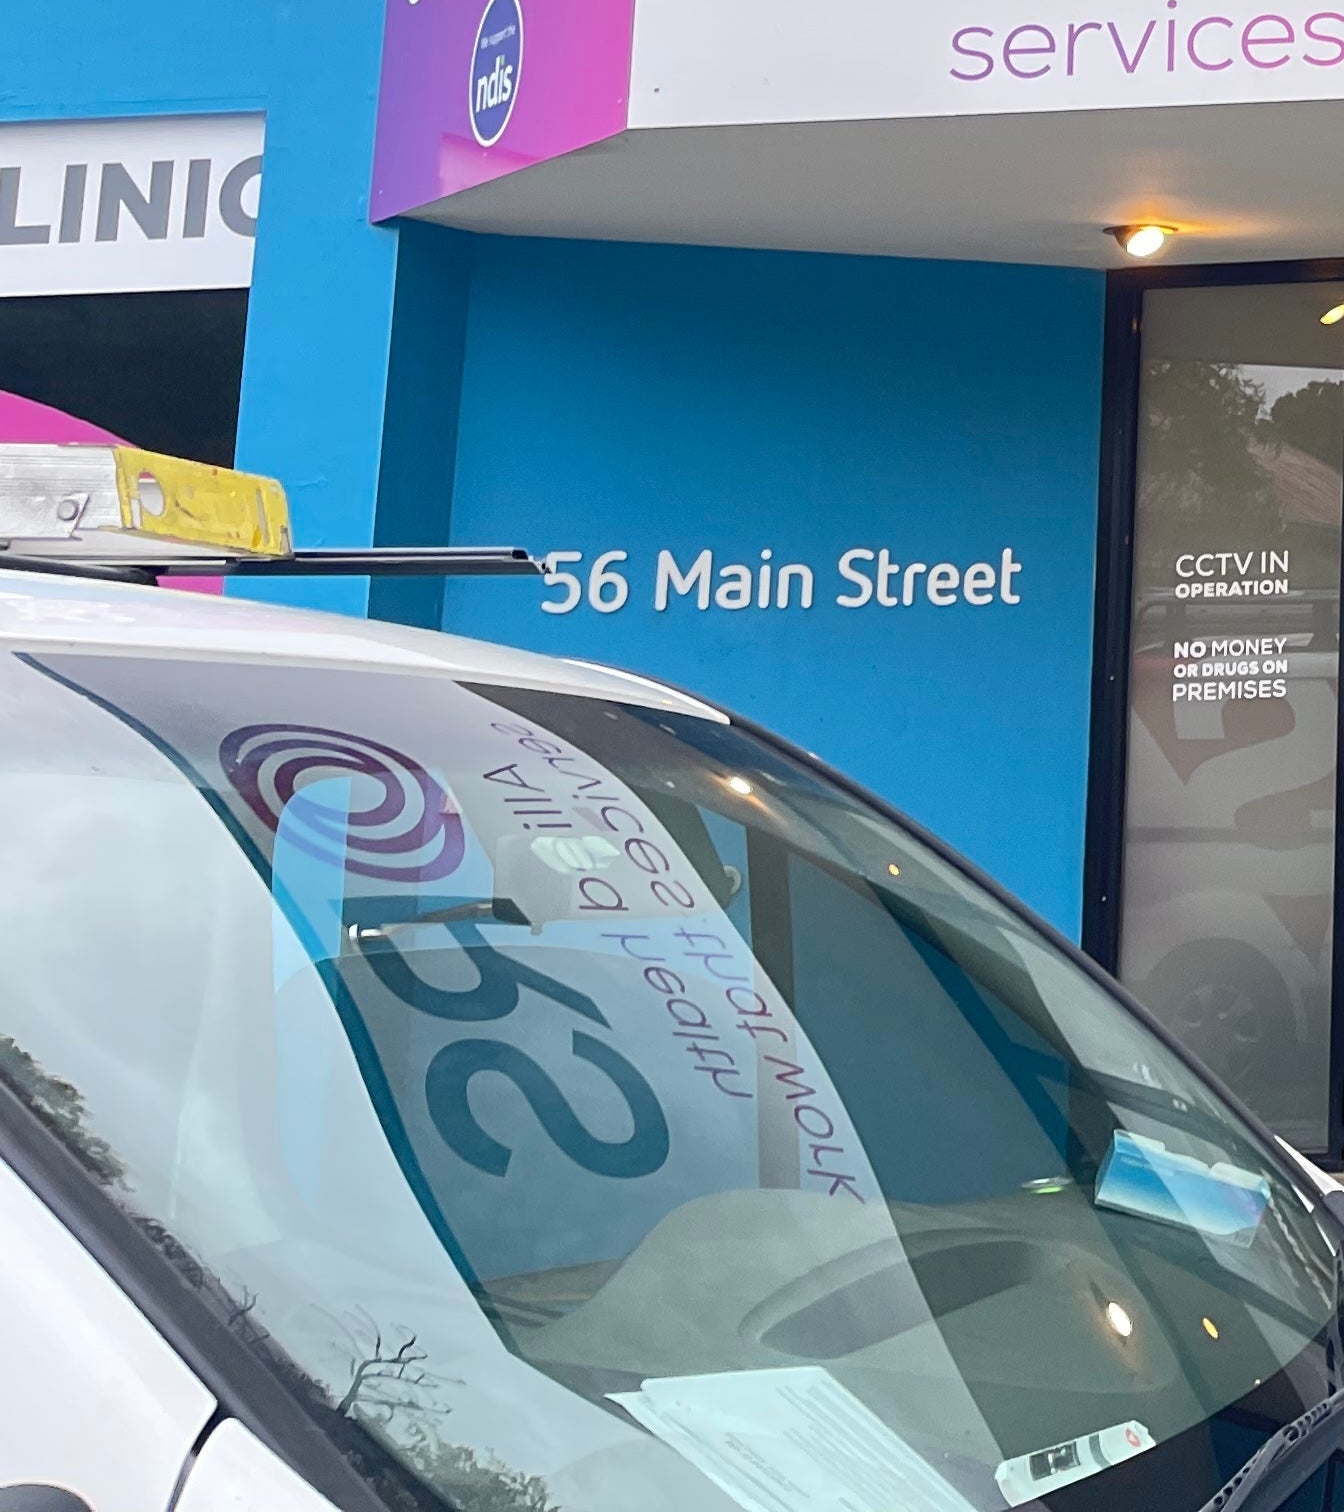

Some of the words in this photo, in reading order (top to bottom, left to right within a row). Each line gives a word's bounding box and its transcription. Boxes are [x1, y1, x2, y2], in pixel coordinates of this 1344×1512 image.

[475, 55, 513, 114] ndis
[1175, 551, 1254, 578] CCTV
[1260, 549, 1290, 574] IN
[539, 550, 630, 616] 56
[653, 548, 814, 612] Main
[836, 546, 1023, 608] Street
[1174, 578, 1289, 599] OPERATION
[1173, 640, 1207, 659] NO
[1210, 637, 1288, 657] MONEY
[1173, 662, 1199, 678] OR
[1201, 659, 1260, 677] DRUGS
[1262, 659, 1289, 675] ON
[1172, 678, 1288, 702] PREMISES
